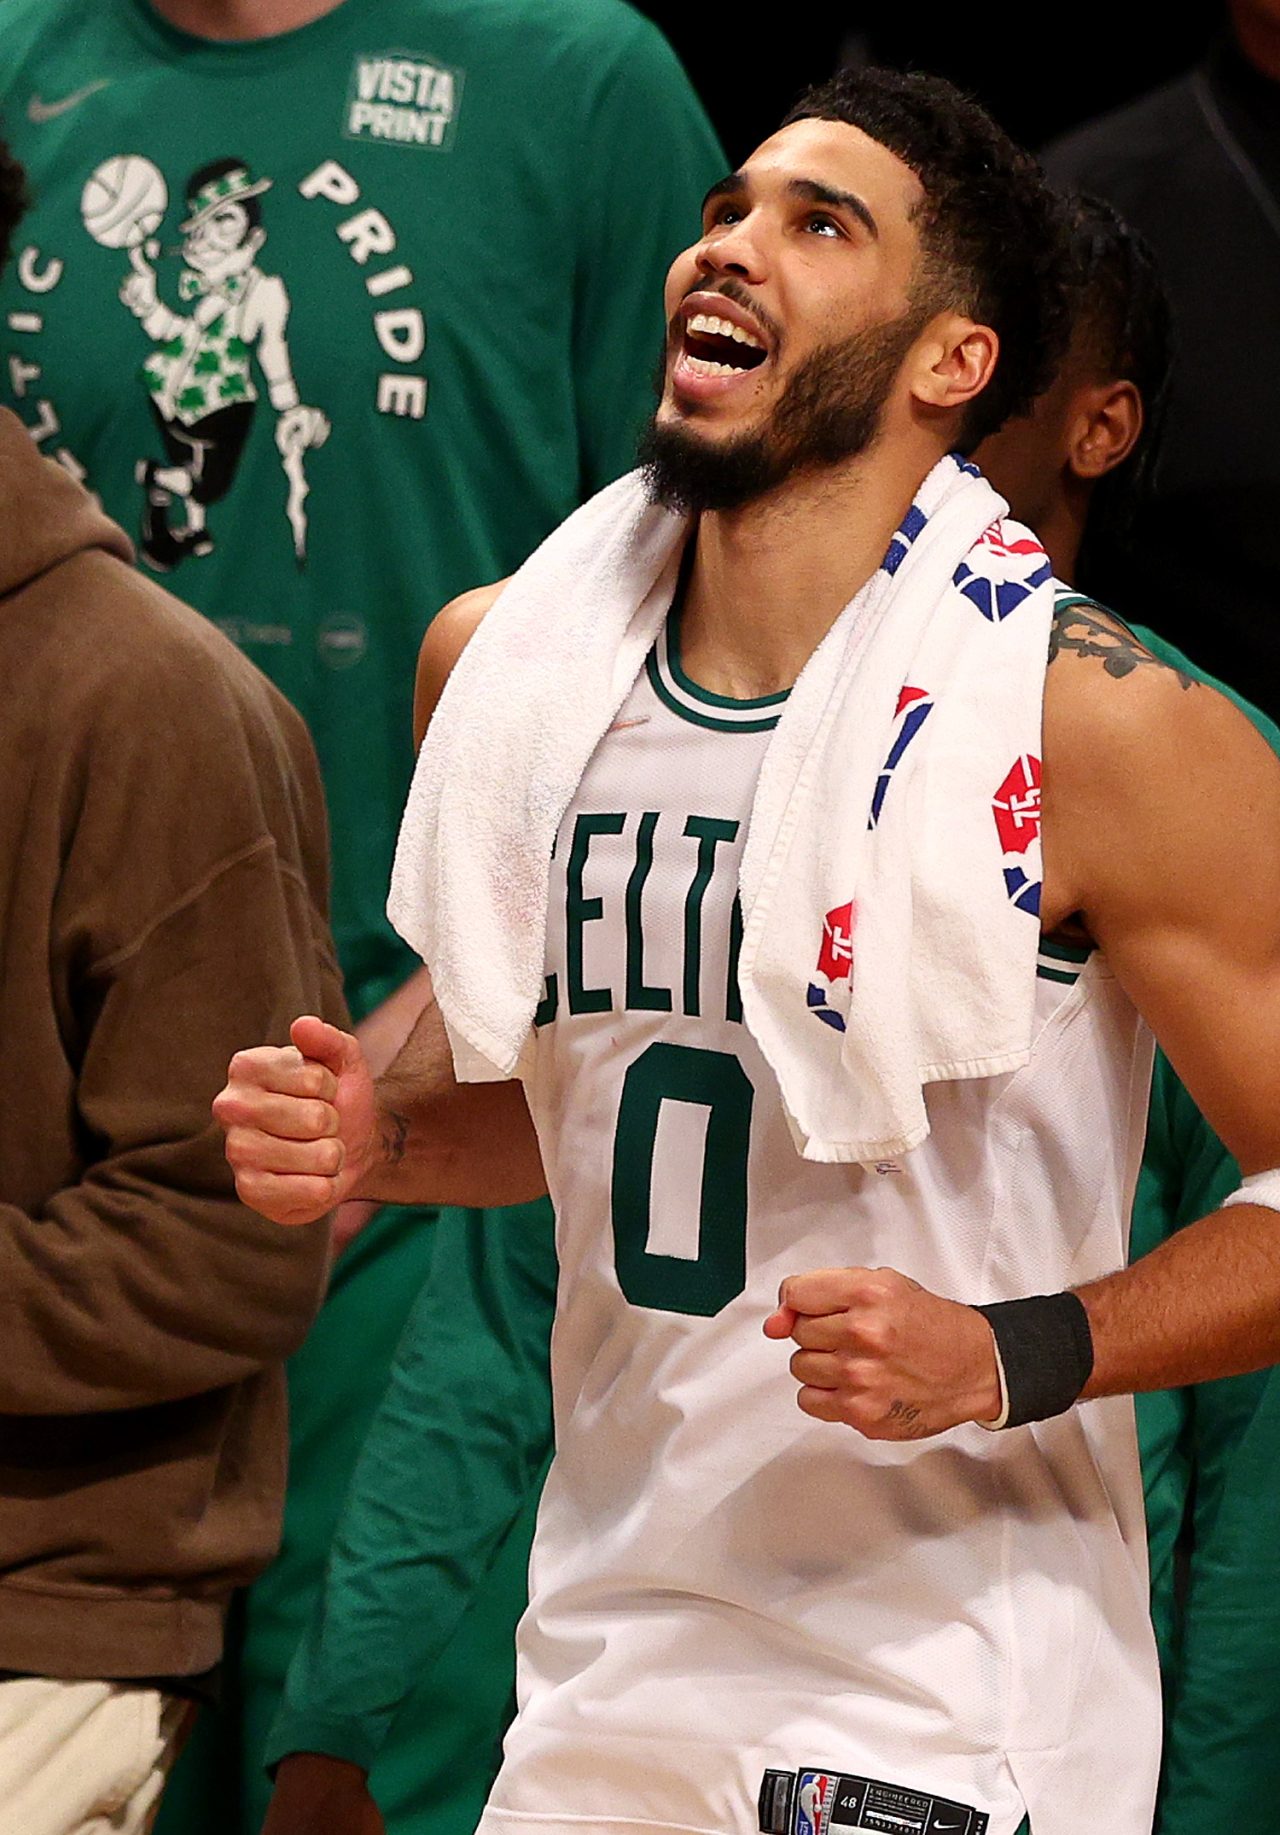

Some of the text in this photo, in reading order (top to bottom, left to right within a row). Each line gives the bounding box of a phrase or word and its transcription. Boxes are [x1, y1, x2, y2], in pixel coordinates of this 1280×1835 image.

[358, 58, 453, 114] VISTA
[349, 100, 449, 146] PRINT
[298, 158, 429, 420] PRIDE
[611, 1041, 755, 1318] 0
[840, 1796, 858, 1809] 48
